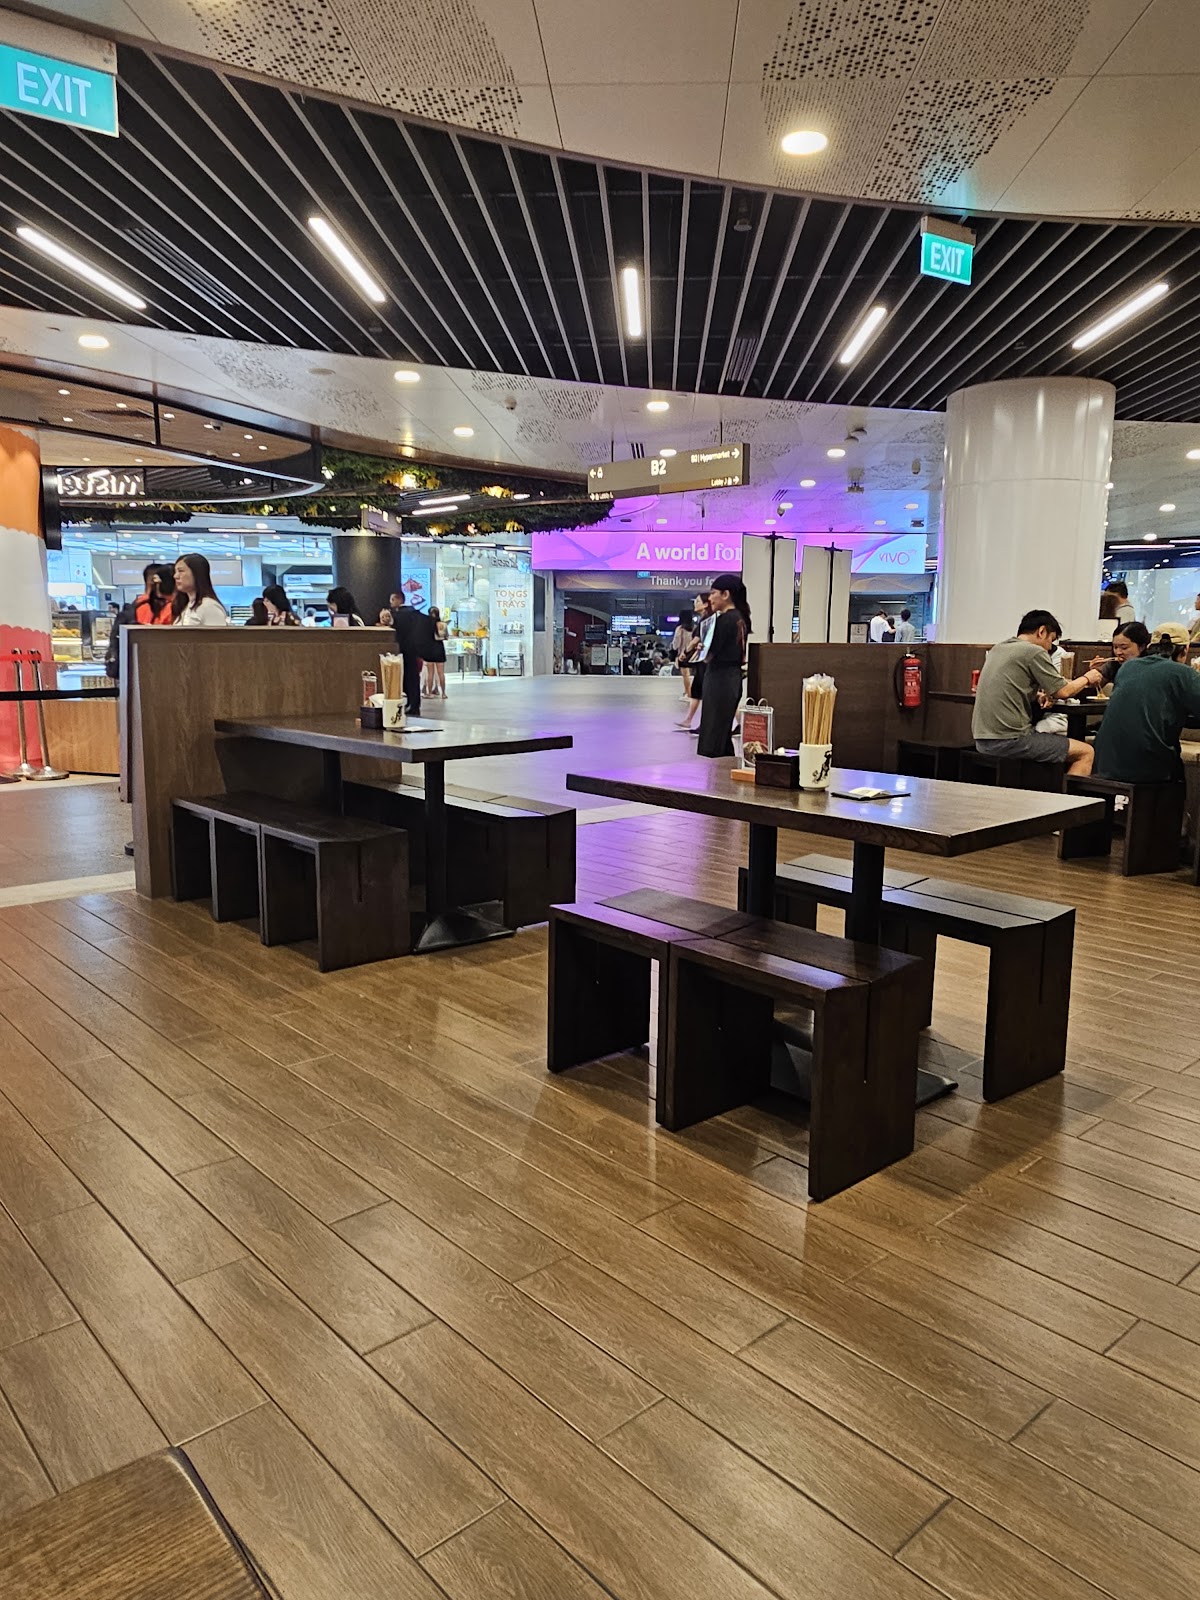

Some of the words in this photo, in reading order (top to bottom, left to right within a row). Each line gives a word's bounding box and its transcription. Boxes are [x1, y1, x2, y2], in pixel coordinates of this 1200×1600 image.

[16, 61, 92, 118] EXIT
[930, 241, 965, 276] EXIT
[650, 459, 667, 476] B2
[636, 542, 651, 560] A
[654, 542, 709, 561] world
[650, 575, 682, 587] Thank
[684, 577, 702, 588] you
[495, 590, 528, 598] TONGS
[496, 600, 526, 608] TRAYS
